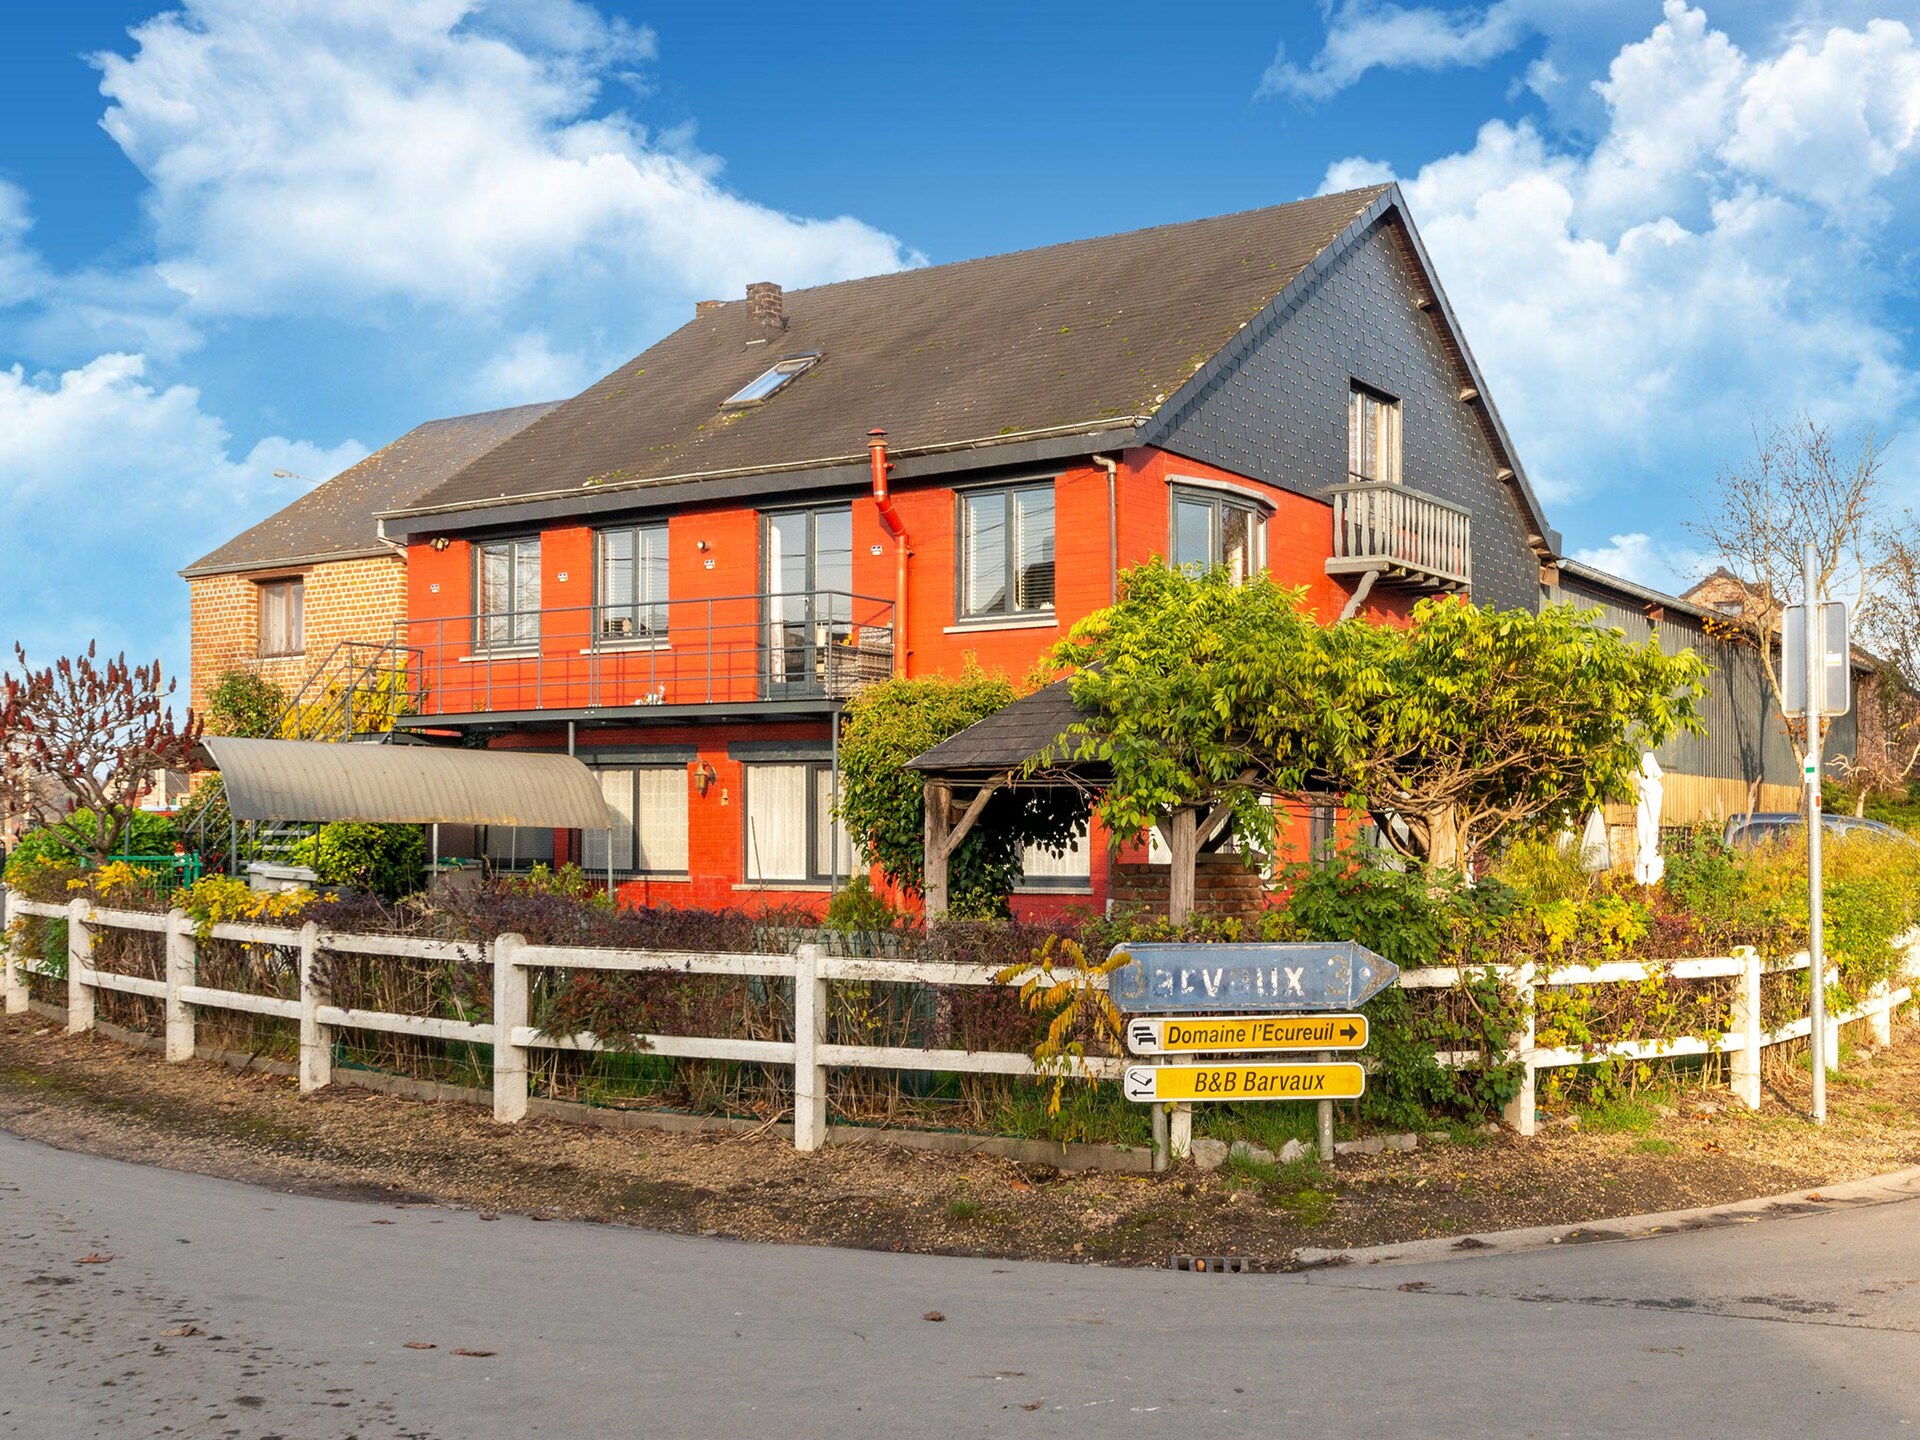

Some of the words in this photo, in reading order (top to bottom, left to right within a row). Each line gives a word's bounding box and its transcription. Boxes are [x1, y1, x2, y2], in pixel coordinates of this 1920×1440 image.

[1327, 954, 1348, 996] 3
[1168, 1025, 1246, 1045] Domaine
[1251, 1022, 1335, 1043] l'Ecureuil
[1194, 1072, 1237, 1092] B&B
[1243, 1071, 1326, 1092] Barvaux
